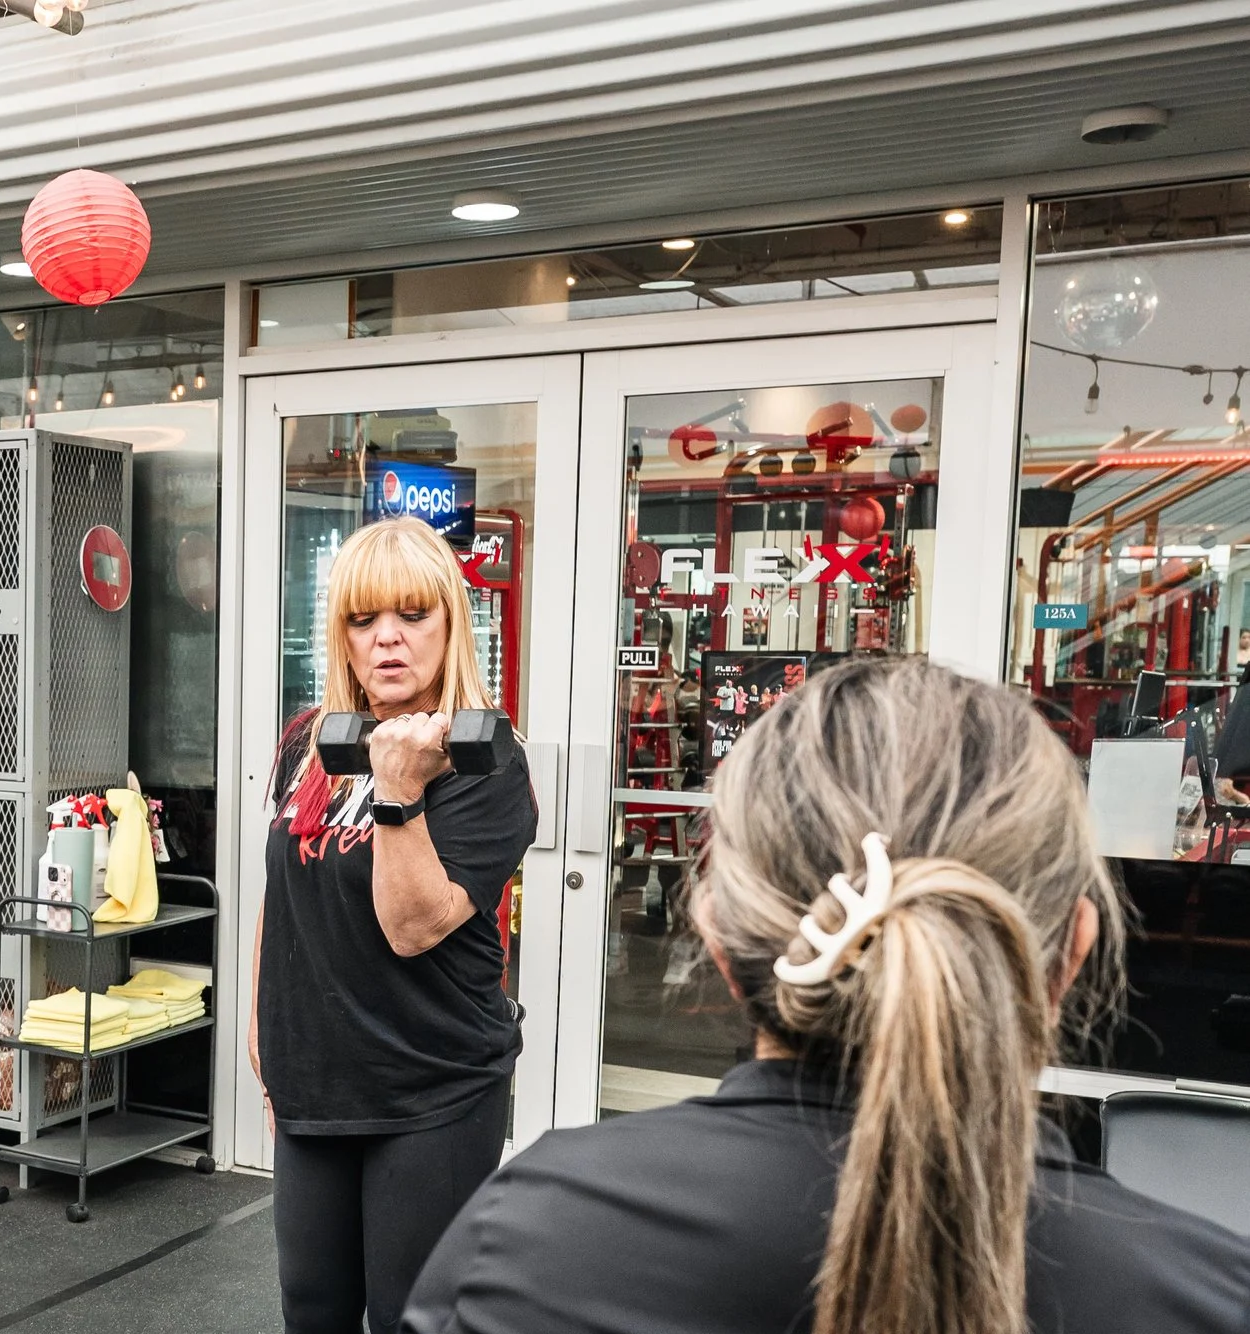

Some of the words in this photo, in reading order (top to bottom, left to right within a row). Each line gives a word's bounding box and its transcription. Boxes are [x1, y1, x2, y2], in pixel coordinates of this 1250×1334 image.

[405, 484, 456, 520] pepsi
[659, 586, 878, 601] FITNESS
[692, 603, 840, 619] HAWAII
[1044, 607, 1077, 619] 125A
[621, 652, 653, 665] PULL
